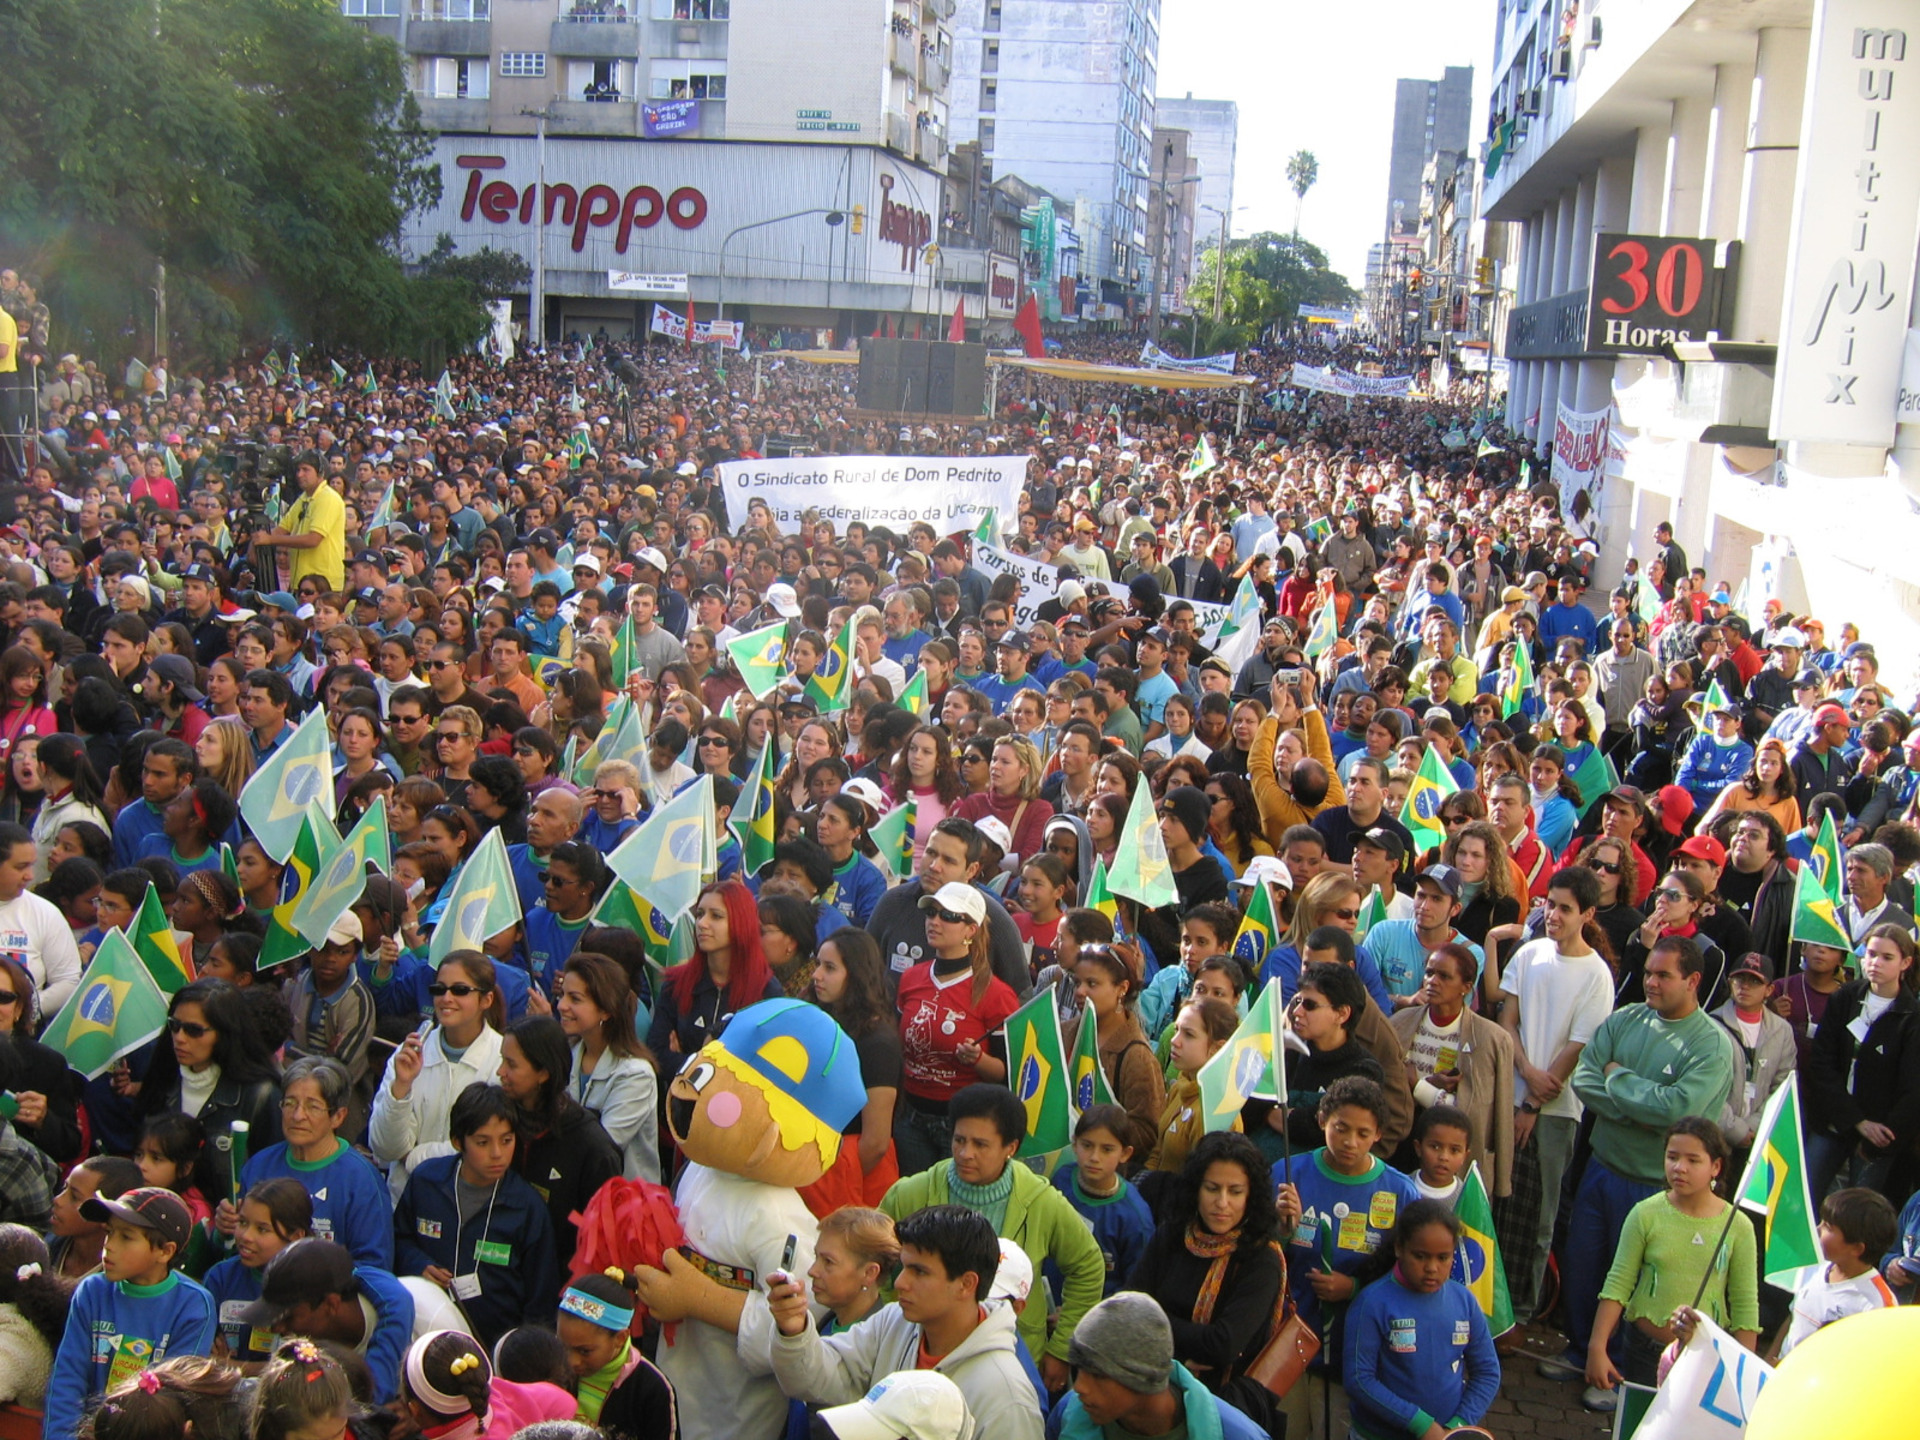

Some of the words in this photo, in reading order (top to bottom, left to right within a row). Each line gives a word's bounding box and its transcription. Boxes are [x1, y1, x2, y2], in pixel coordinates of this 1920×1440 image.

[456, 155, 708, 254] Temppo
[1601, 240, 1704, 317] 30
[1603, 319, 1691, 348] Horas
[738, 473, 749, 487] O
[754, 471, 828, 486] Sindicato
[833, 469, 875, 484] Rural
[881, 468, 899, 482] de
[904, 467, 940, 482] Dom
[946, 467, 1002, 482] Pedrito
[922, 506, 941, 520] da
[978, 546, 1026, 579] Cursos
[1032, 566, 1049, 586] de
